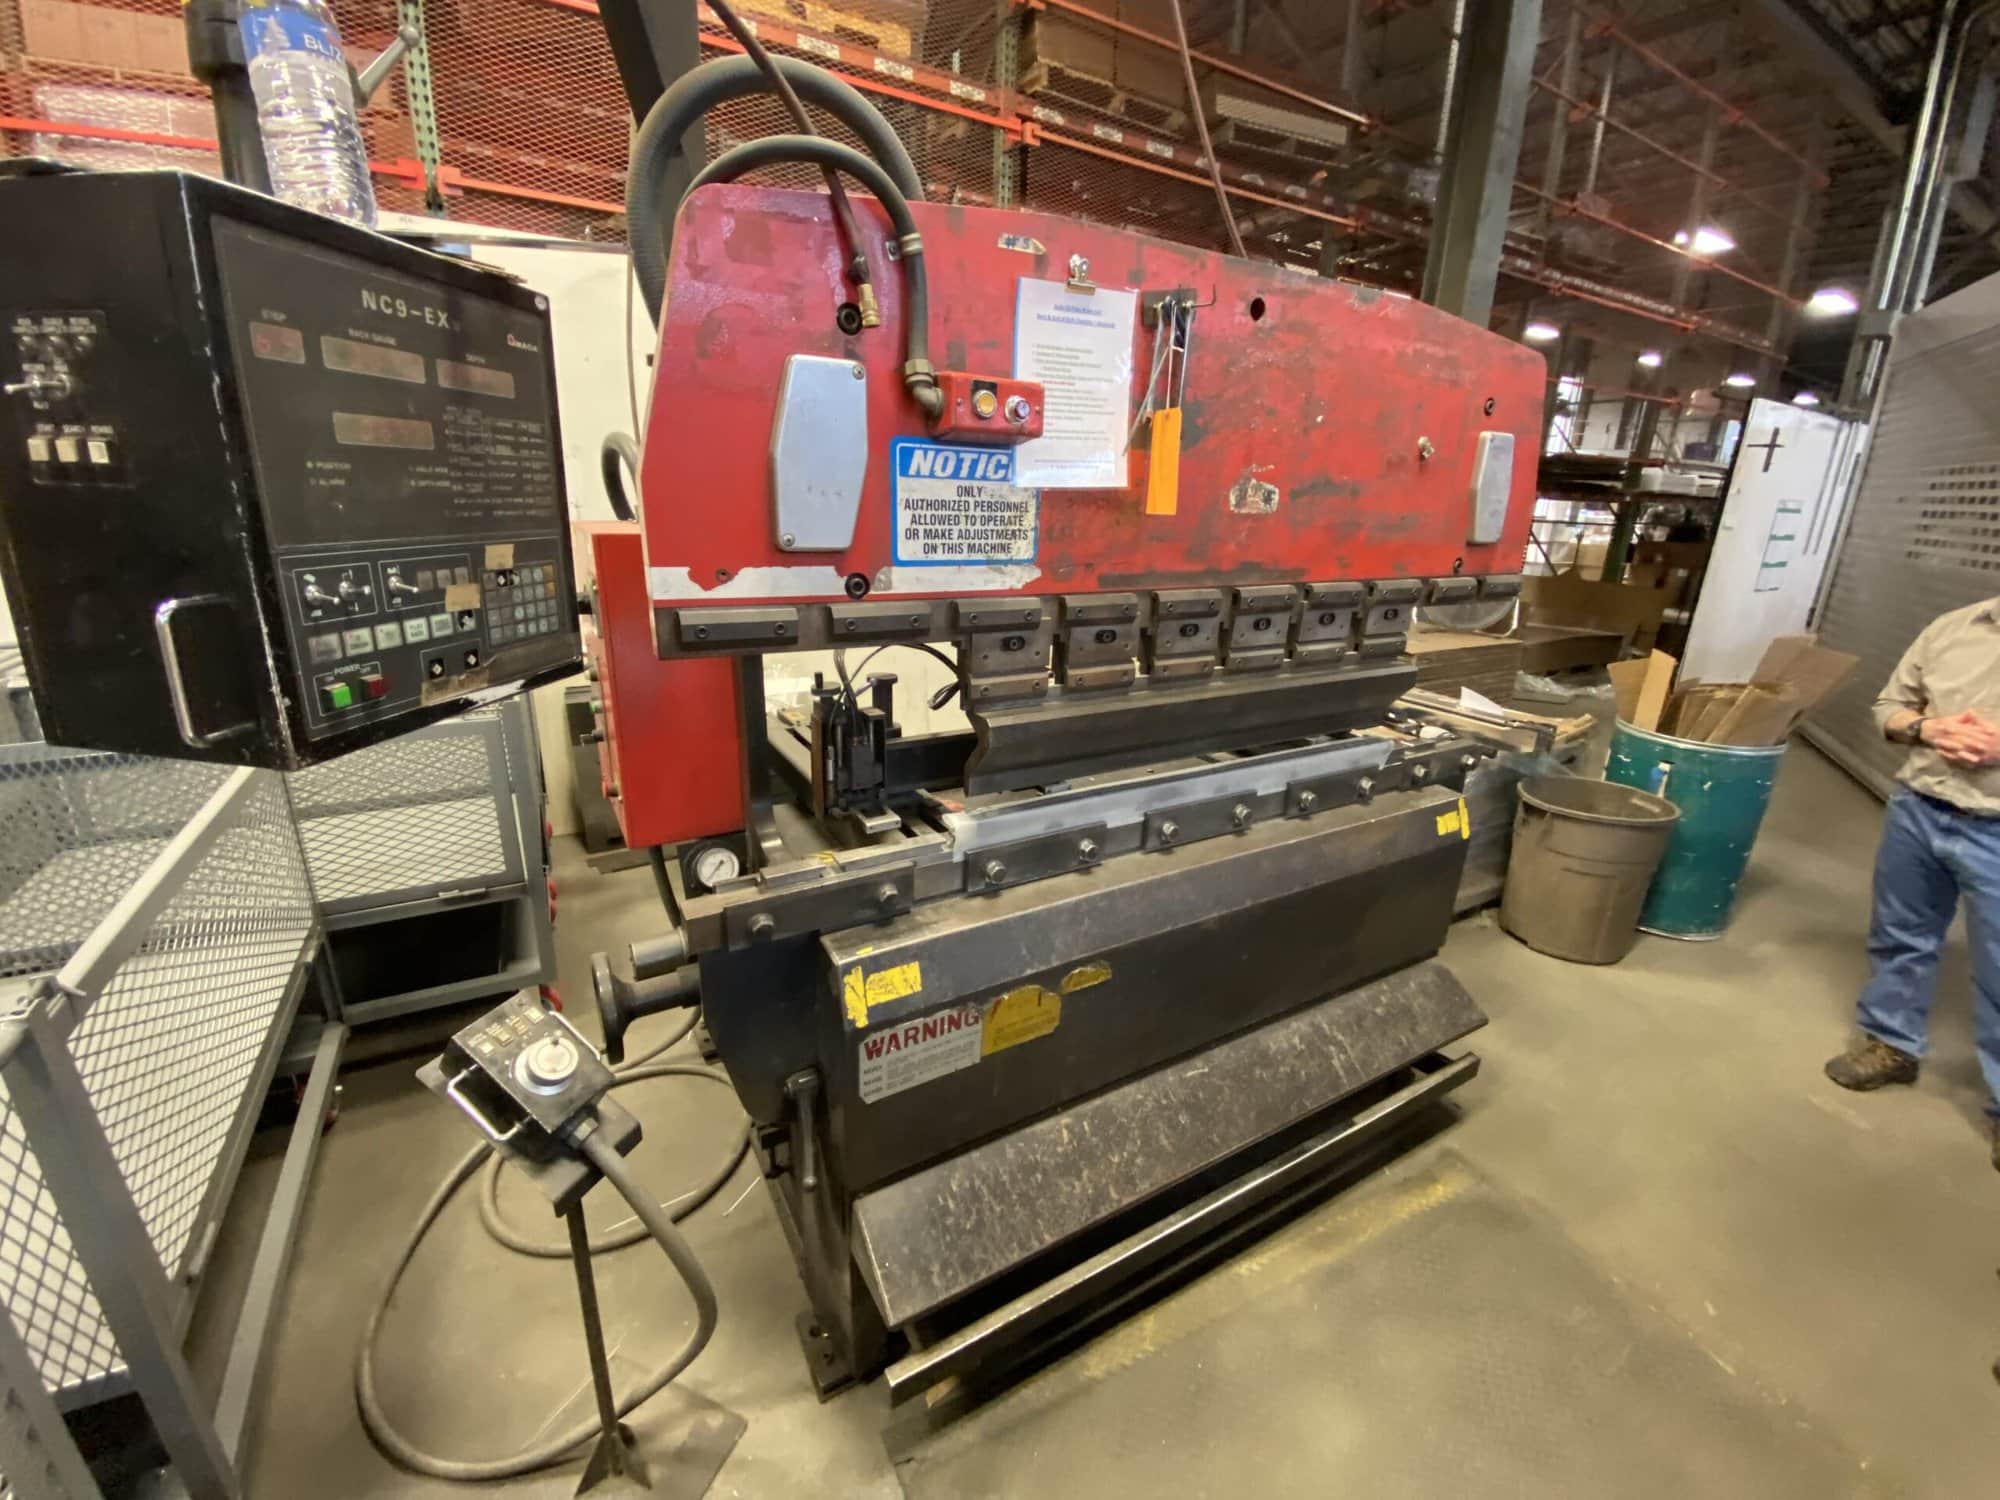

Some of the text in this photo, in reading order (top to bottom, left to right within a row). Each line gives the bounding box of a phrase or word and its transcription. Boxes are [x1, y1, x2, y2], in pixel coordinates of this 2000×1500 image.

[361, 289, 450, 329] NC9-EX
[908, 449, 1011, 480] NOTIC
[956, 485, 984, 498] ONLY
[904, 499, 1029, 513] AUTHORIZED PERSONNEL
[910, 514, 1024, 527] ALLOWED TO OPERATE
[905, 528, 1028, 541] OR MAKE ADJUSTMENTS
[923, 543, 1012, 555] ON THIS MACHINE
[334, 663, 361, 676] POWER
[863, 1011, 980, 1061] WARNING
